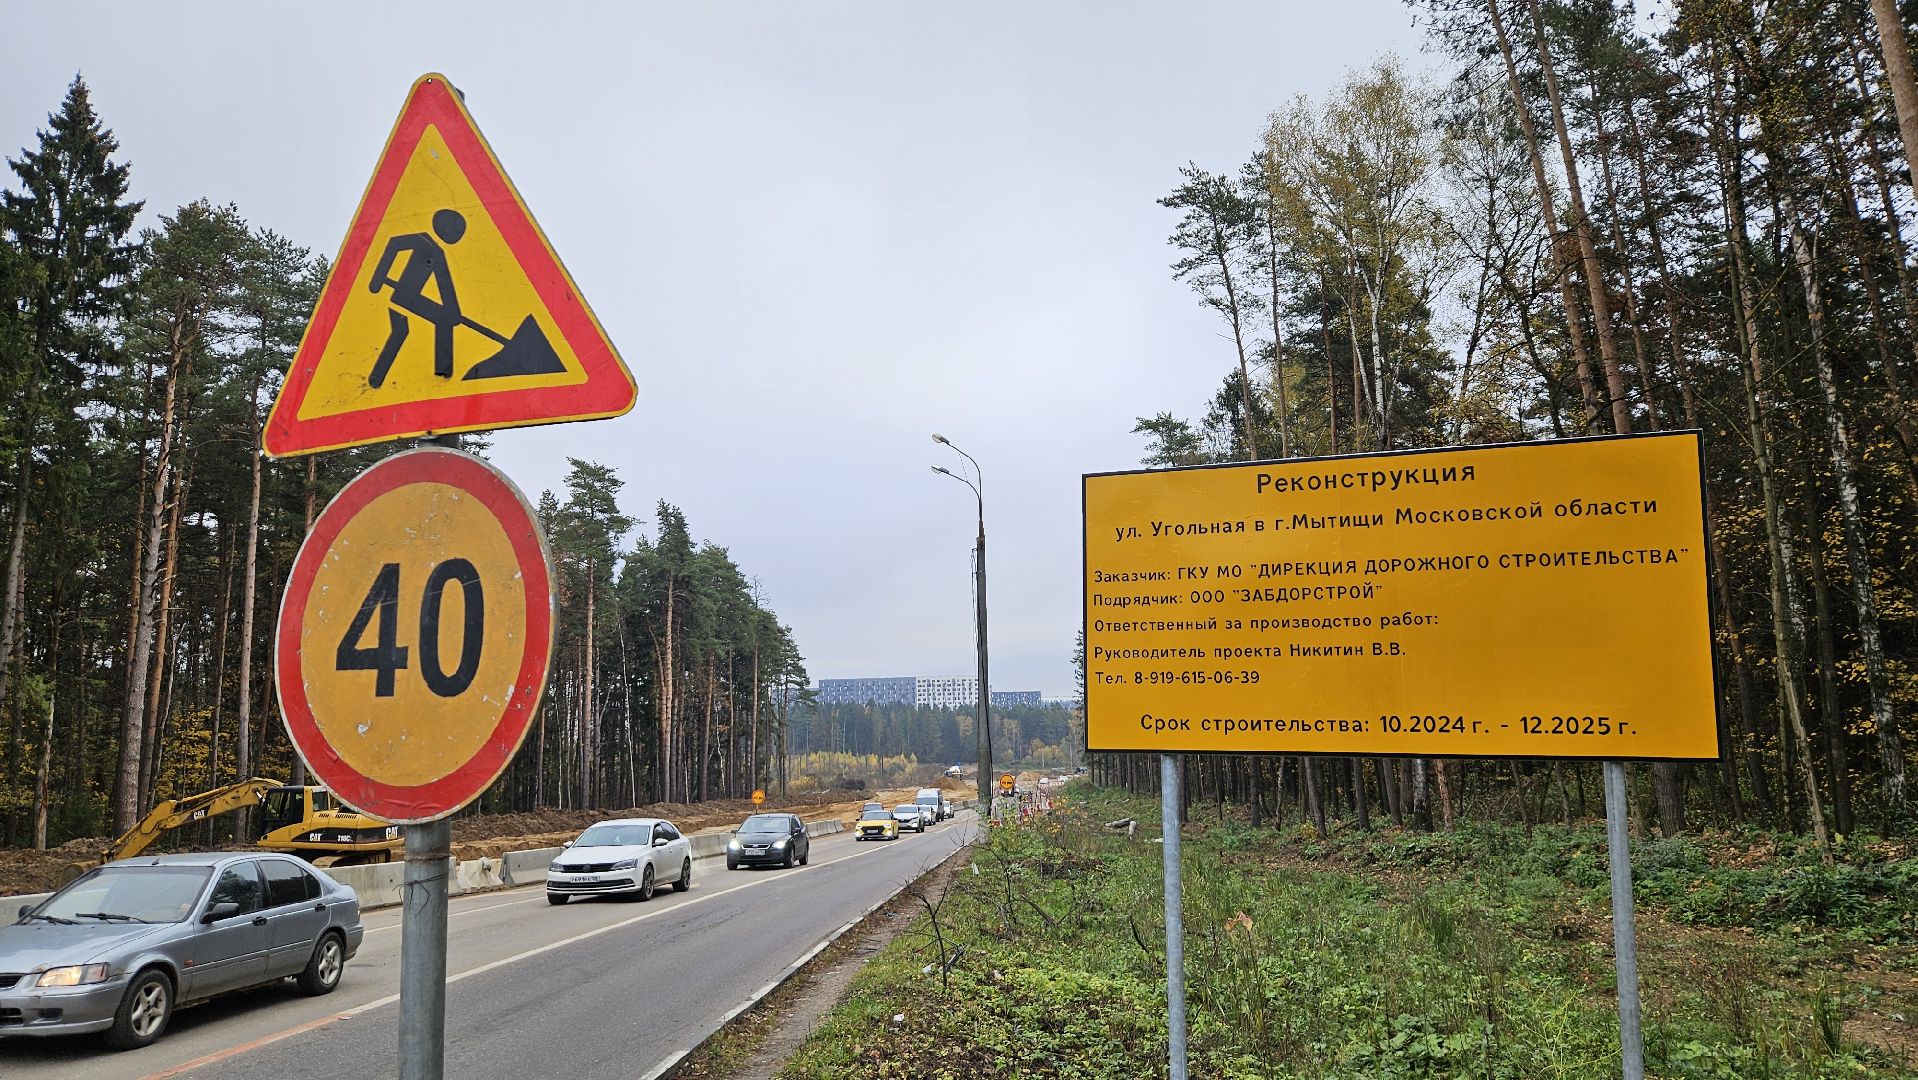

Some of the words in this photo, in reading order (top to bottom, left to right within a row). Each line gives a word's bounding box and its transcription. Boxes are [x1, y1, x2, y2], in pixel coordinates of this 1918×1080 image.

[1257, 466, 1476, 494] Реконструкция
[1115, 524, 1142, 543] ул.
[1150, 521, 1245, 537] Угольная
[1254, 520, 1265, 532] в
[1275, 513, 1384, 531] г.Мытищи
[1395, 499, 1543, 525] Московской
[1554, 498, 1657, 517] области
[1094, 569, 1170, 583] Заказчик:
[1178, 566, 1209, 580] ГКУ
[1217, 564, 1242, 578] МО
[1250, 560, 1357, 579] "ДИРЕКЦИЯ
[1364, 554, 1490, 576] ДОРОЖНОГО
[1498, 548, 1689, 569] СТРОИТЕЛЬСТВА"
[1093, 593, 1183, 609] Подрядчик:
[1190, 589, 1225, 604] ООО
[1232, 581, 1382, 603] "ЗАБДОРСТРОЙ"
[336, 557, 485, 698] 40
[1094, 616, 1217, 632] Ответственный
[1224, 619, 1242, 630] за
[1250, 616, 1372, 633] производство
[1380, 611, 1438, 630] работ:
[1094, 646, 1206, 662] Руководитель
[1214, 646, 1282, 661] проекта
[1289, 643, 1364, 657] Никитин
[1372, 642, 1406, 656] В.В.
[1095, 671, 1127, 685] Тел.
[1134, 670, 1260, 685] 8-919-615-06-39
[1140, 714, 1191, 734] Срок
[1201, 718, 1369, 736] строительства:
[193, 809, 206, 821] CAT
[309, 833, 321, 842] CAT
[385, 826, 398, 840] CAT
